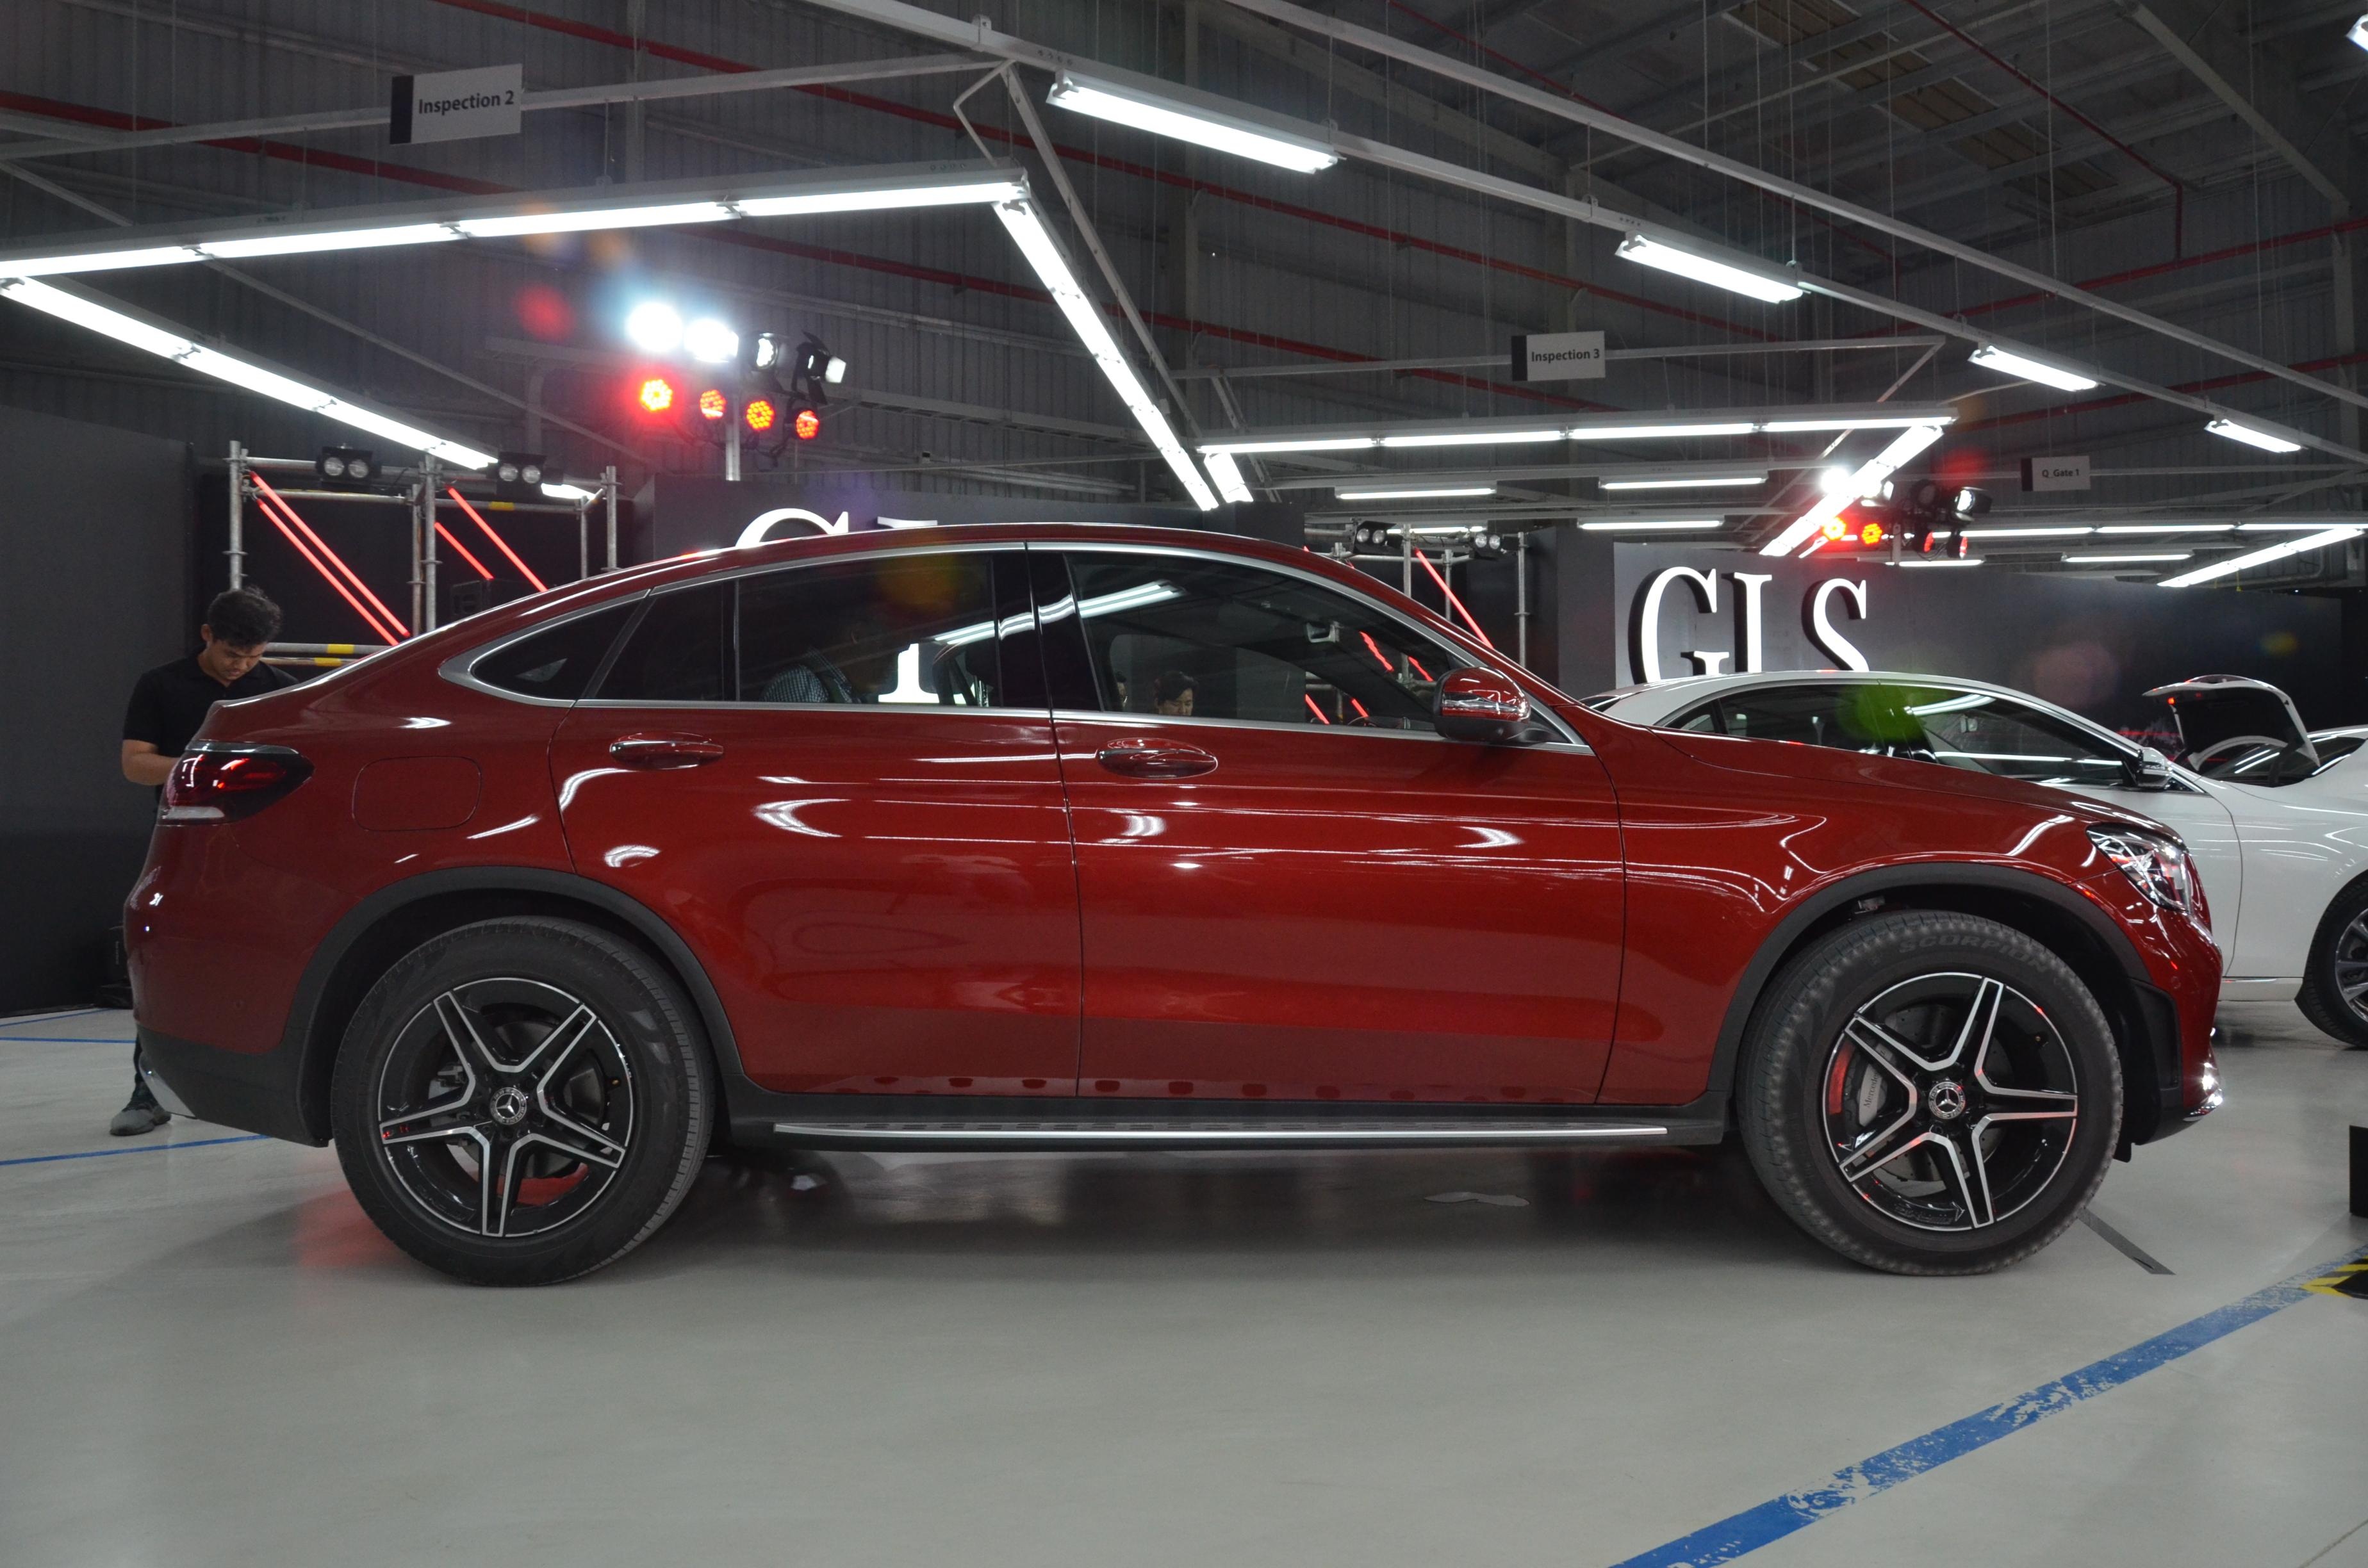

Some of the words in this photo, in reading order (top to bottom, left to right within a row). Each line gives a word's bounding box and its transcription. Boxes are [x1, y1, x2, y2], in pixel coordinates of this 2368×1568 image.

[418, 93, 500, 115] Inspection
[505, 90, 514, 105] 2
[1531, 350, 1590, 363] Inspection
[1593, 348, 1600, 359] 3
[1898, 935, 2050, 972] SCORPION
